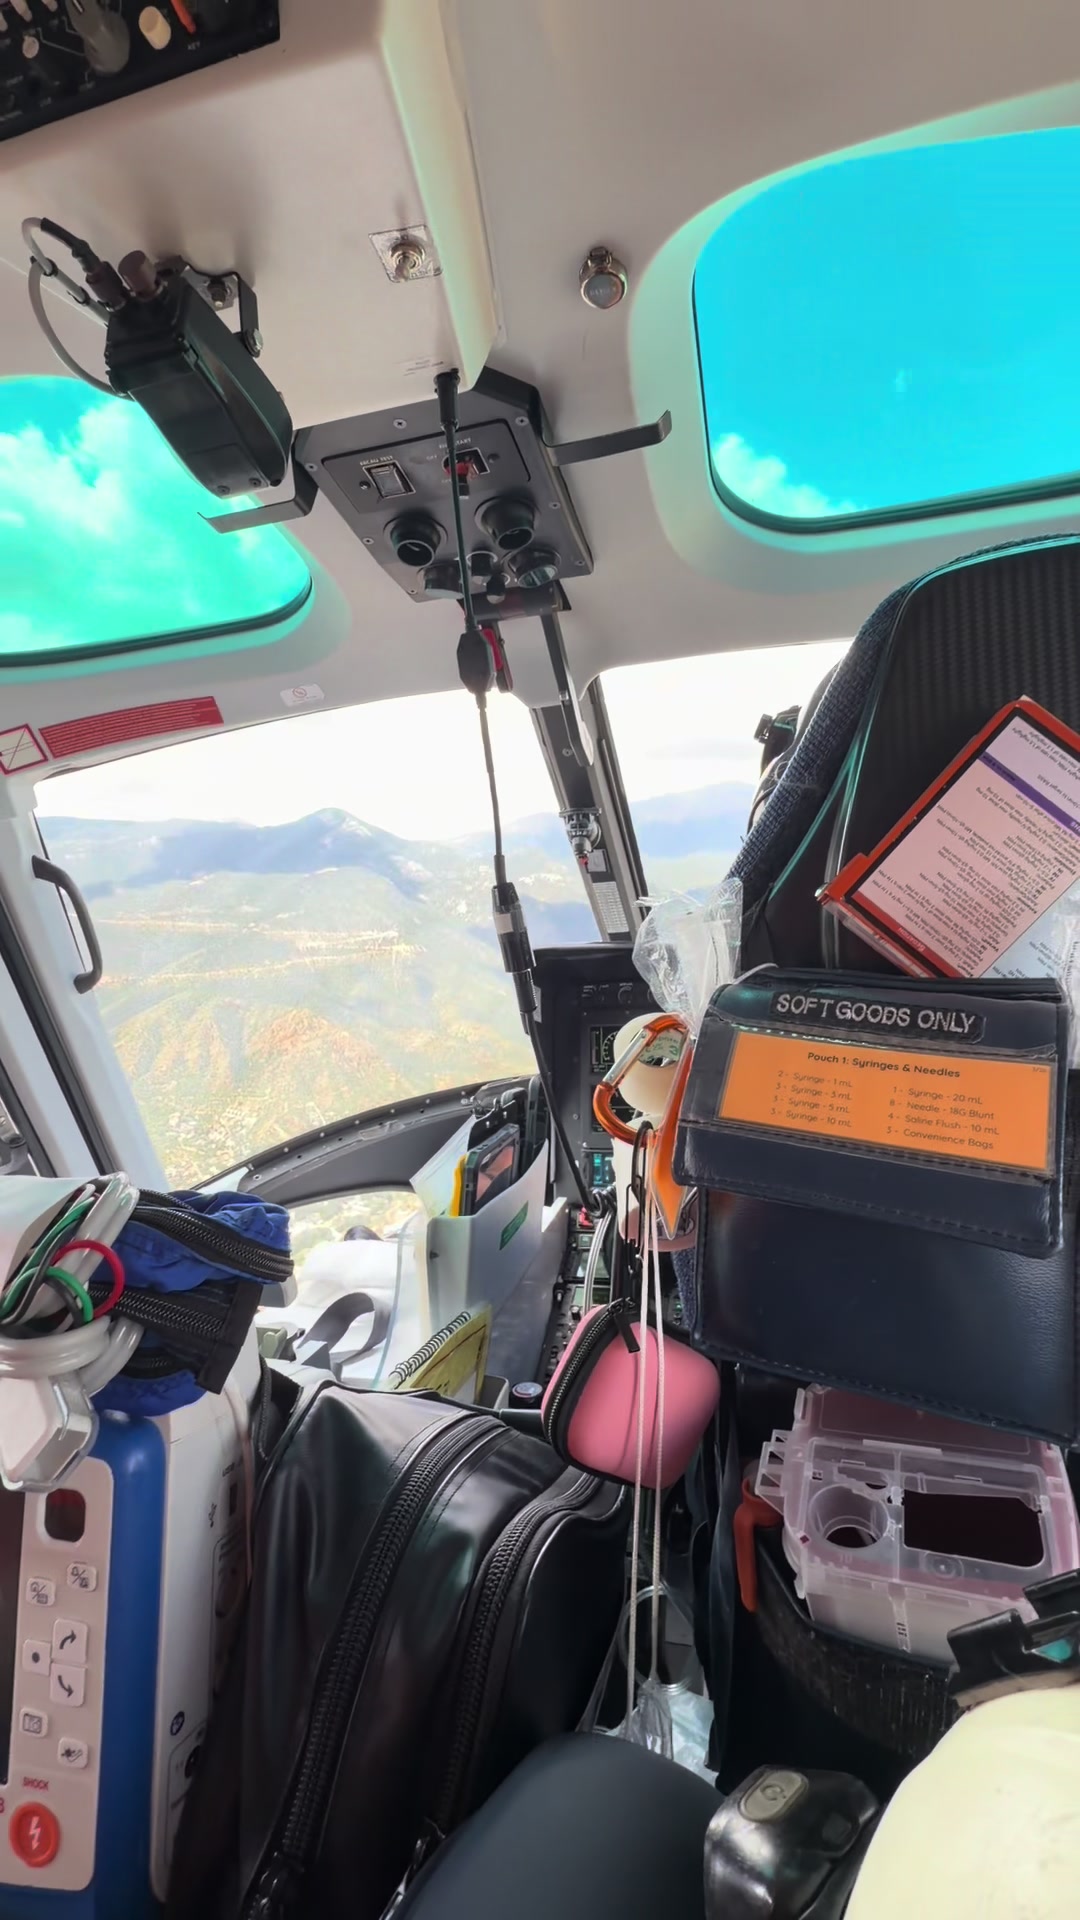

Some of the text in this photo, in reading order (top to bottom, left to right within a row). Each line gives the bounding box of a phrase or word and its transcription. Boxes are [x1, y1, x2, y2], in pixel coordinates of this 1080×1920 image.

[776, 993, 976, 1034] SOFT GOODS ONLY
[807, 1051, 961, 1078] Pouch 1: Syringes & Needles
[793, 1072, 825, 1084] Syringe
[839, 1080, 852, 1088] mL
[791, 1084, 823, 1097] Syringe
[908, 1087, 944, 1100] Syringe
[952, 1093, 966, 1103] 20
[967, 1096, 983, 1105] mL
[788, 1097, 820, 1109] Syringe
[836, 1105, 850, 1113] mL
[906, 1101, 940, 1113] Needle
[969, 1109, 994, 1120] Blunt
[786, 1110, 818, 1122] Syringe
[827, 1116, 836, 1125] 10
[838, 1119, 852, 1127] mL
[905, 1114, 933, 1126] Saline
[936, 1119, 961, 1130] Flush
[971, 1124, 982, 1133] 10
[984, 1126, 1000, 1135] mL
[903, 1128, 965, 1145] Convenience
[968, 1138, 994, 1150] Bags
[22, 1776, 49, 1792] SHOCK
